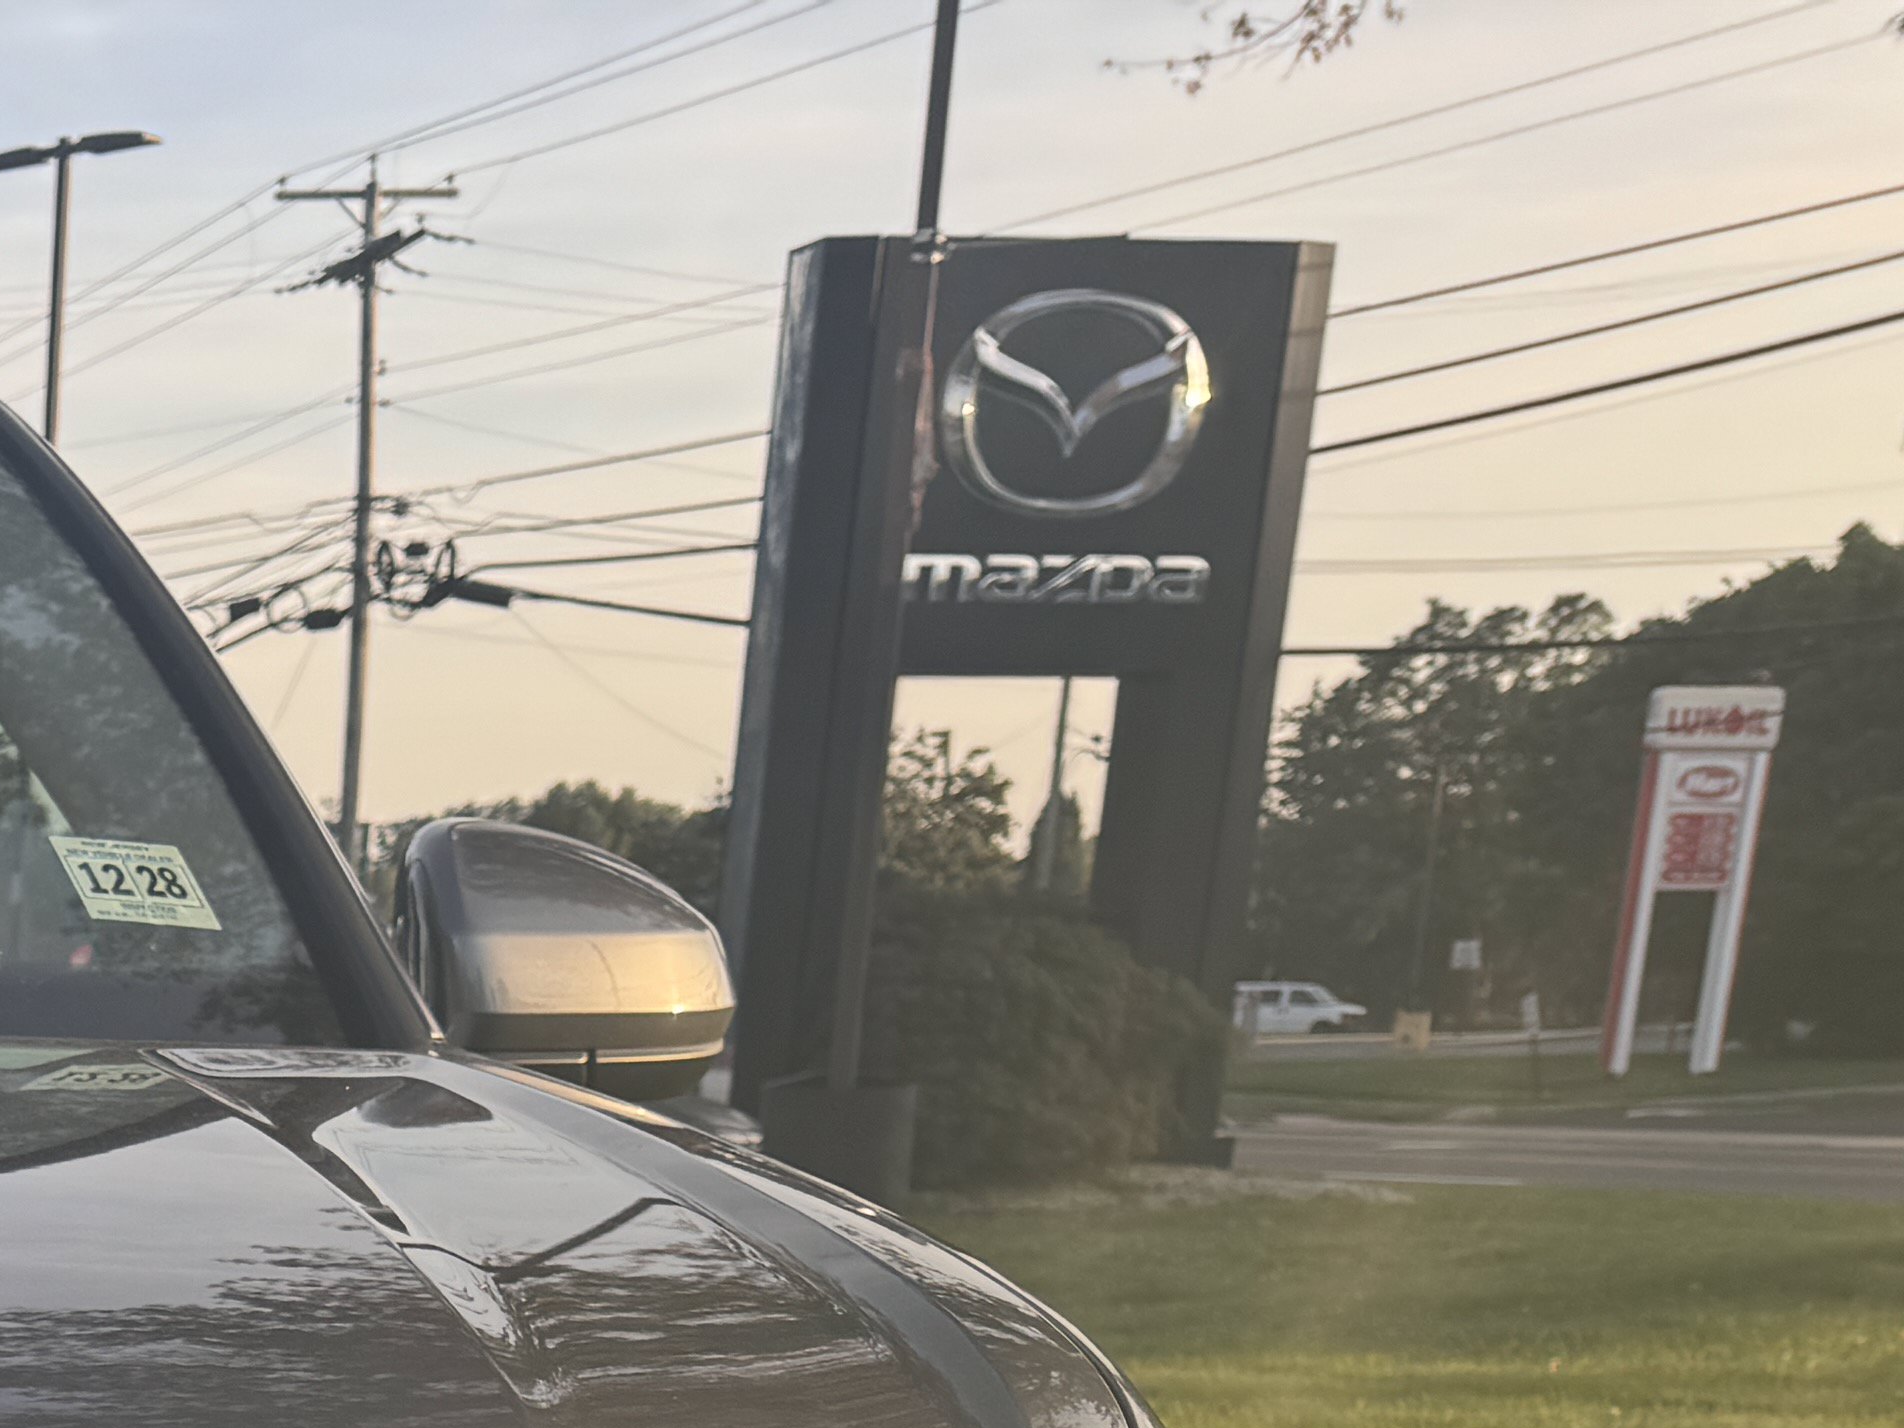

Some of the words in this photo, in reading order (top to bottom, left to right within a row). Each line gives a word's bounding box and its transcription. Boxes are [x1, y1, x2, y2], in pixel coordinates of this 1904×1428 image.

[901, 553, 1211, 602] mazda
[77, 861, 136, 897] 12
[135, 864, 188, 899] 28
